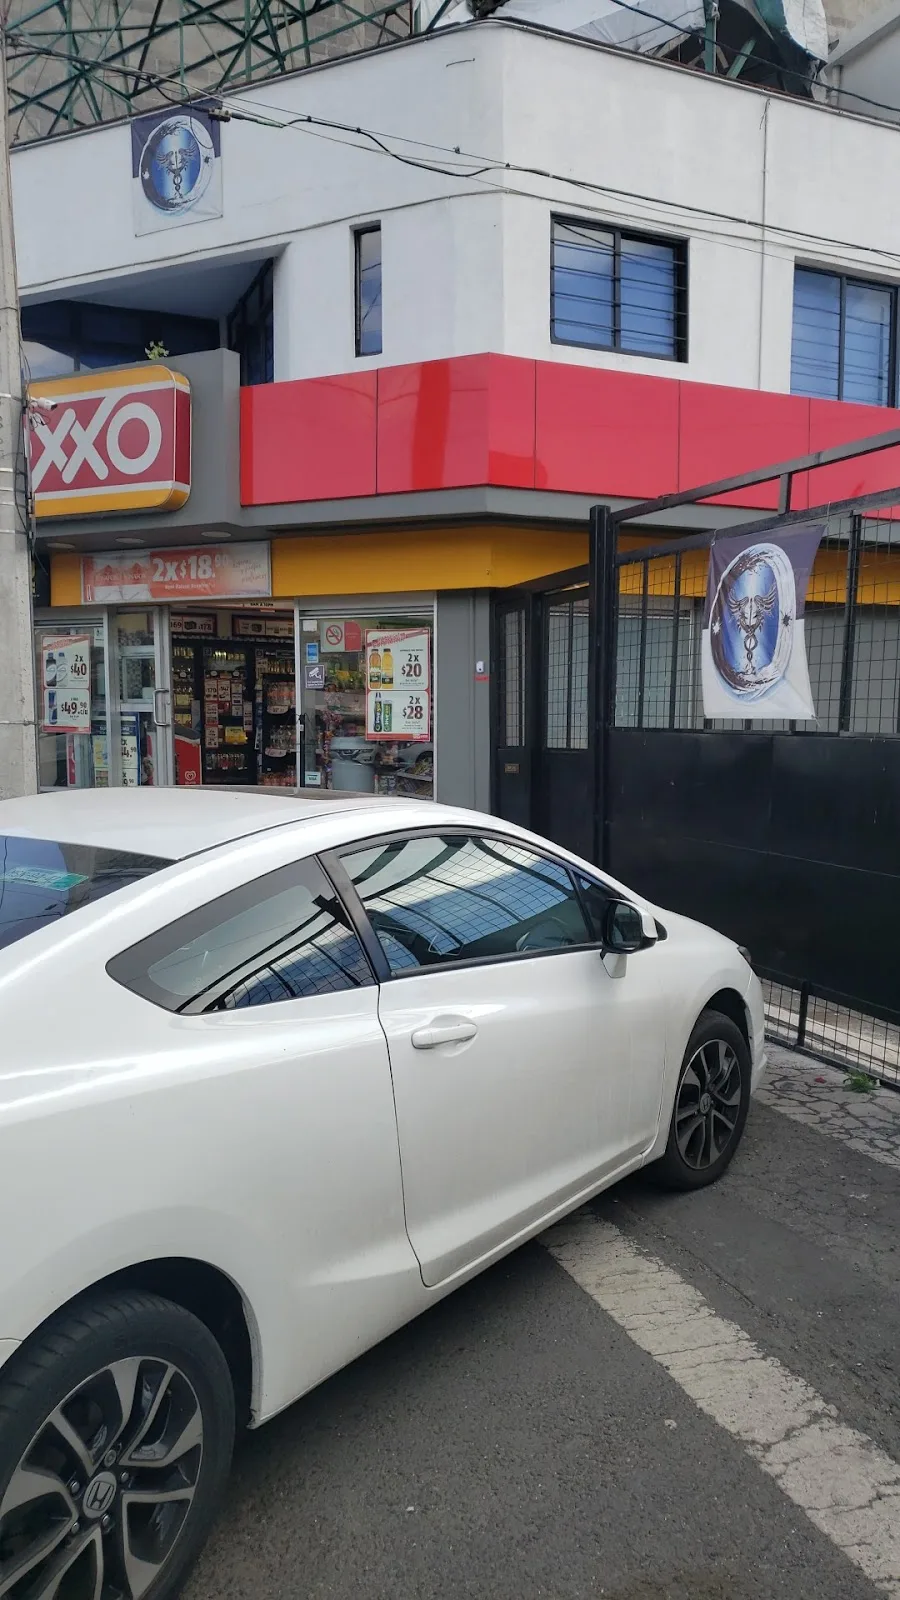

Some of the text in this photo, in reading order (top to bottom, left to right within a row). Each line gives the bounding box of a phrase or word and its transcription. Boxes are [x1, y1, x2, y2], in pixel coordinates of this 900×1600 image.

[30, 391, 162, 491] XXO
[70, 662, 87, 676] $40
[401, 662, 422, 678] $20
[402, 705, 423, 720] $28
